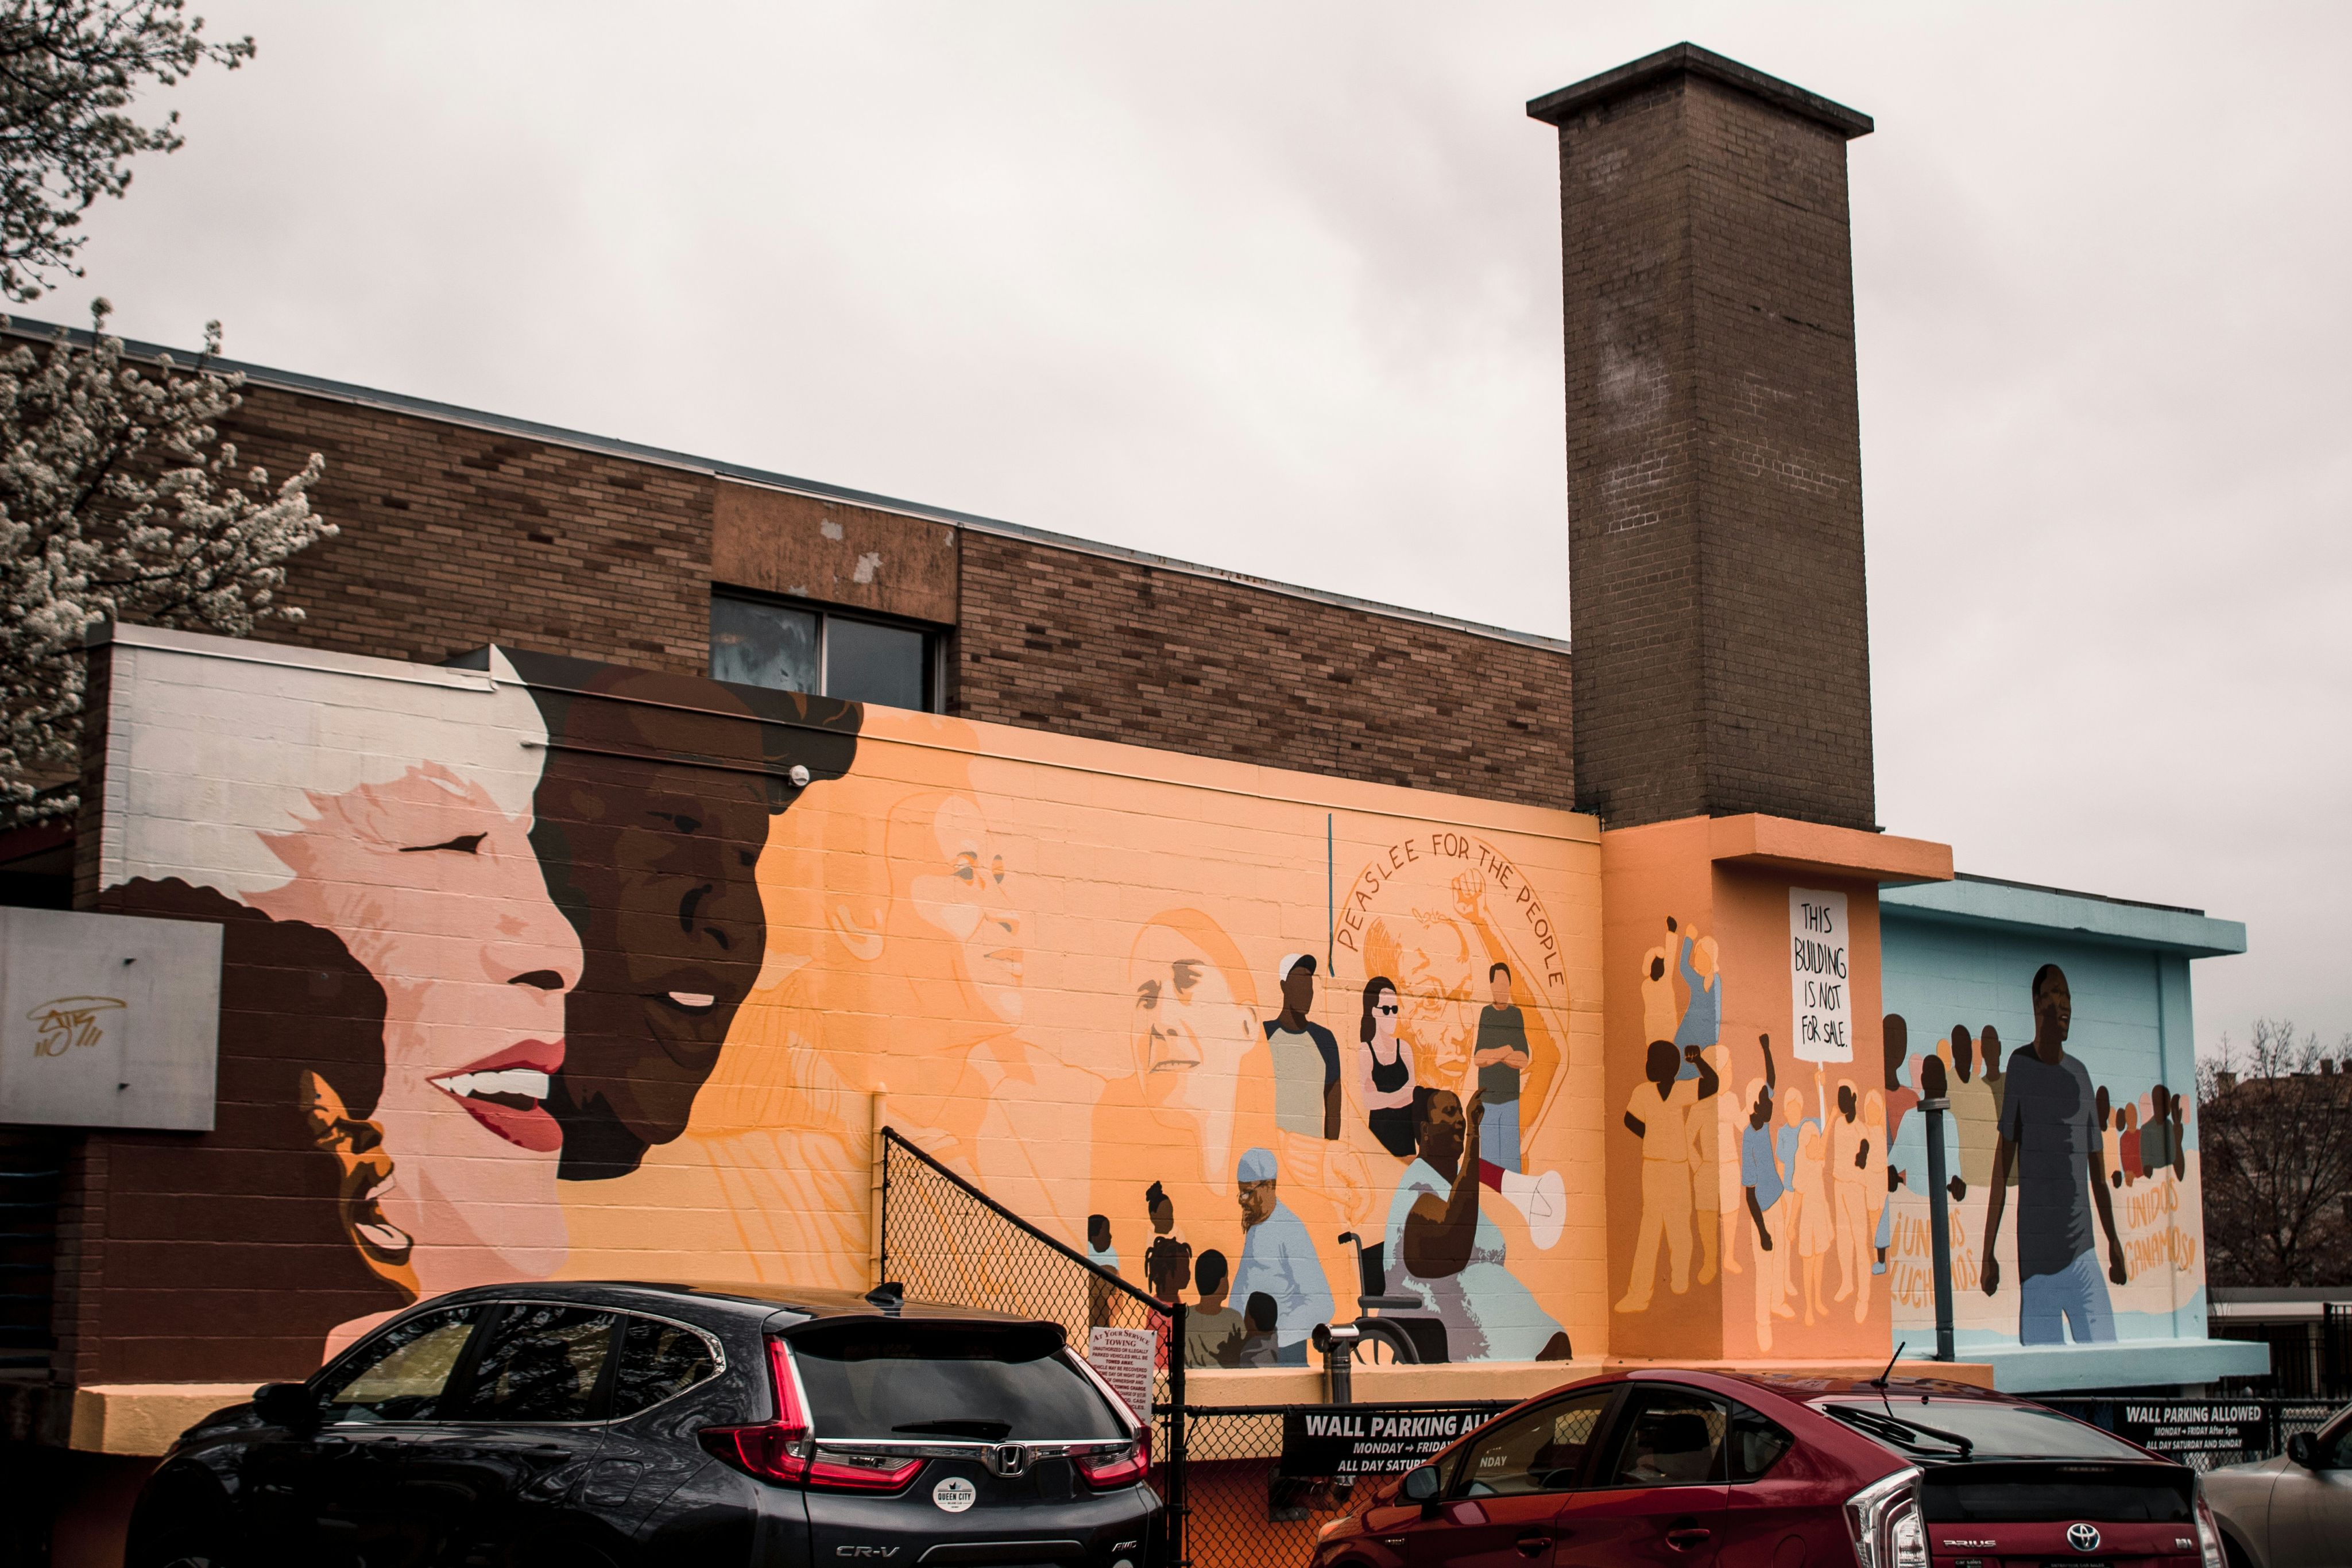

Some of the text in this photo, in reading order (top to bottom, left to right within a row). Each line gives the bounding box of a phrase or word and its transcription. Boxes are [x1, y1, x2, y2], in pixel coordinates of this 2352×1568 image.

[1337, 833, 1564, 988] PEASLEE FOR THE PEOPLE
[1801, 903, 1832, 933] THIS
[1794, 936, 1847, 979] BUILDING
[1804, 980, 1841, 1011] IS NOT
[1802, 1015, 1848, 1047] FOR SALE.
[2126, 1178, 2179, 1229] UNIDOS
[2125, 1225, 2196, 1281] GANAMOS!
[1105, 1339, 1136, 1347] TOWING
[2126, 1406, 2261, 1423] WALL PARKING ALLOWED
[1305, 1415, 1364, 1437] WALL
[1371, 1415, 1457, 1437] PARKING
[2154, 1427, 2181, 1437] MONDAY
[2187, 1426, 2208, 1435] FRIDAY
[1353, 1442, 1405, 1454] MONDAY
[2146, 1439, 2242, 1450] ALL DAY SATURDAY AND SUNDAY
[1337, 1460, 1358, 1472] ALL
[1360, 1460, 1385, 1472] DAY
[836, 1546, 900, 1558] CR-V
